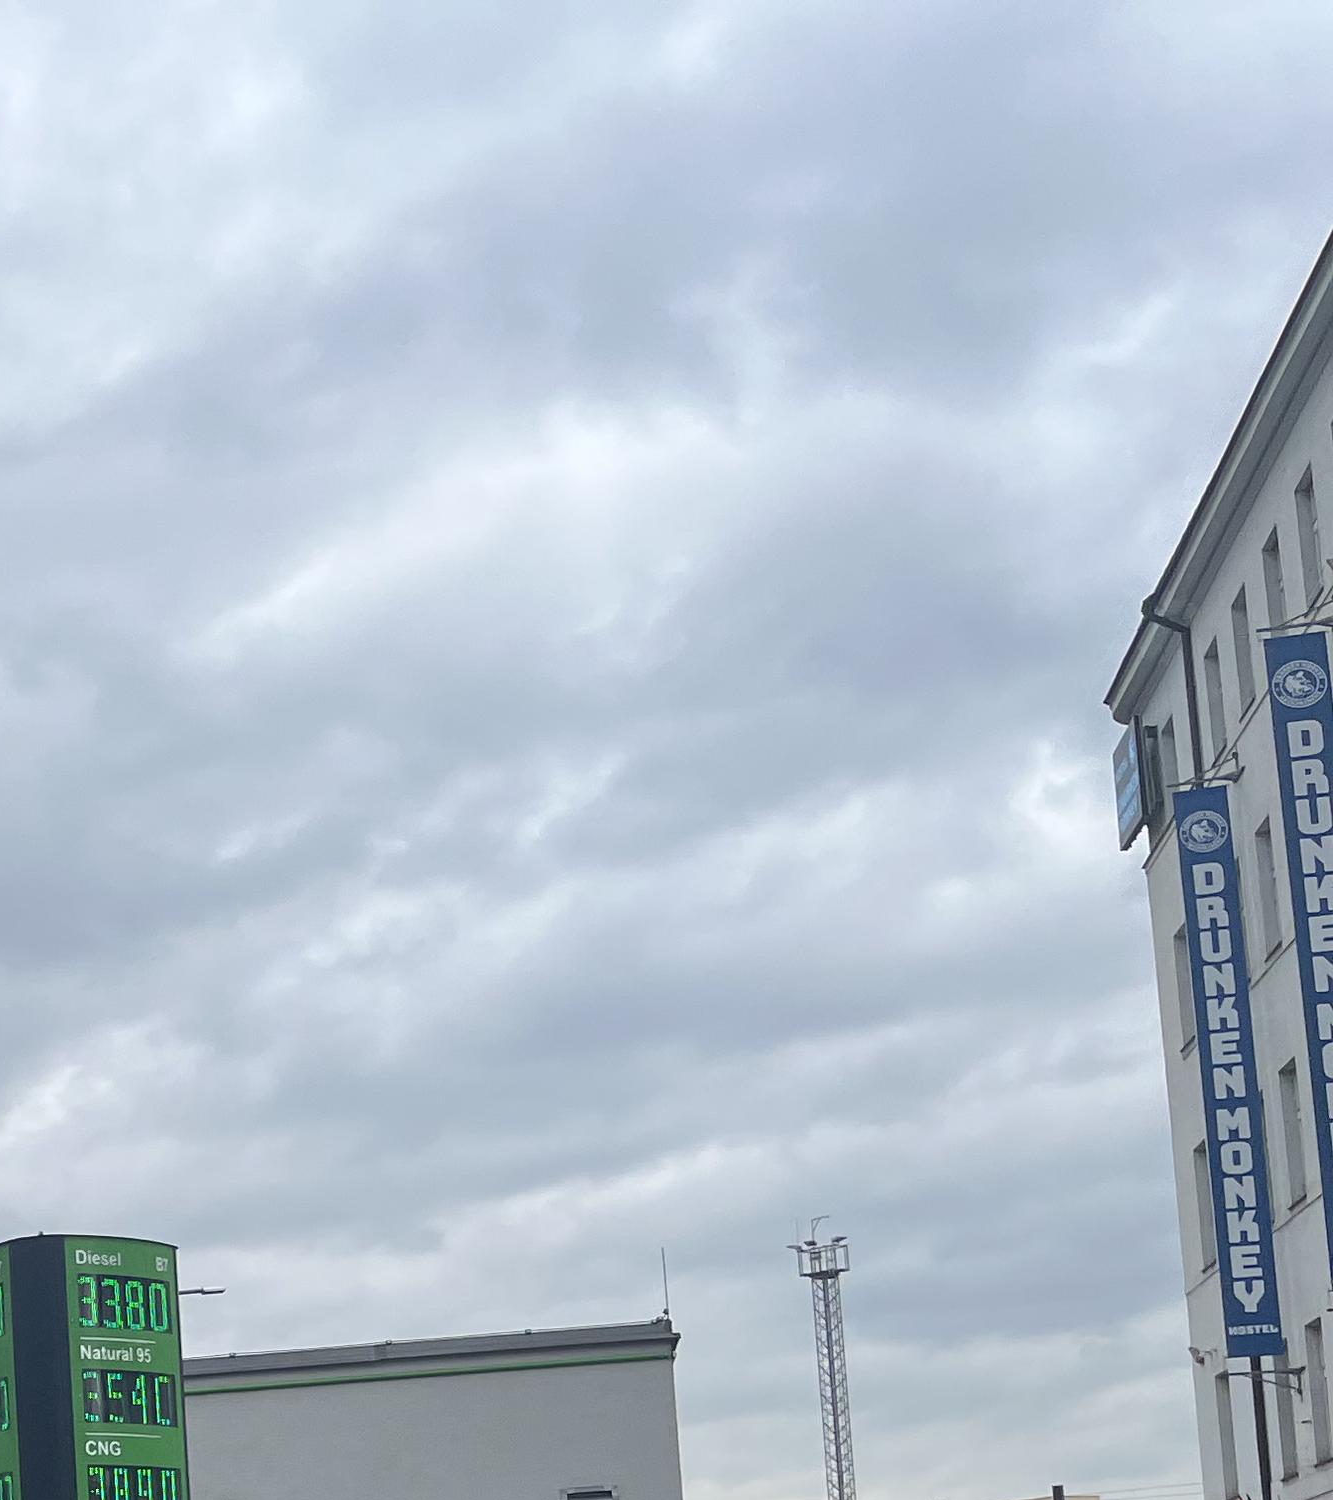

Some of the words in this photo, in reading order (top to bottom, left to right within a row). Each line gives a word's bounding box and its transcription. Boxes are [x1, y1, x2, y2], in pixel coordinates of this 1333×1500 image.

[1191, 862, 1246, 1100] DRUNKEN
[1216, 1106, 1265, 1313] MONKEY
[75, 1249, 122, 1266] Diesel
[80, 1345, 133, 1362] Natural
[137, 1347, 152, 1363] 95
[85, 1440, 122, 1457] CNG
